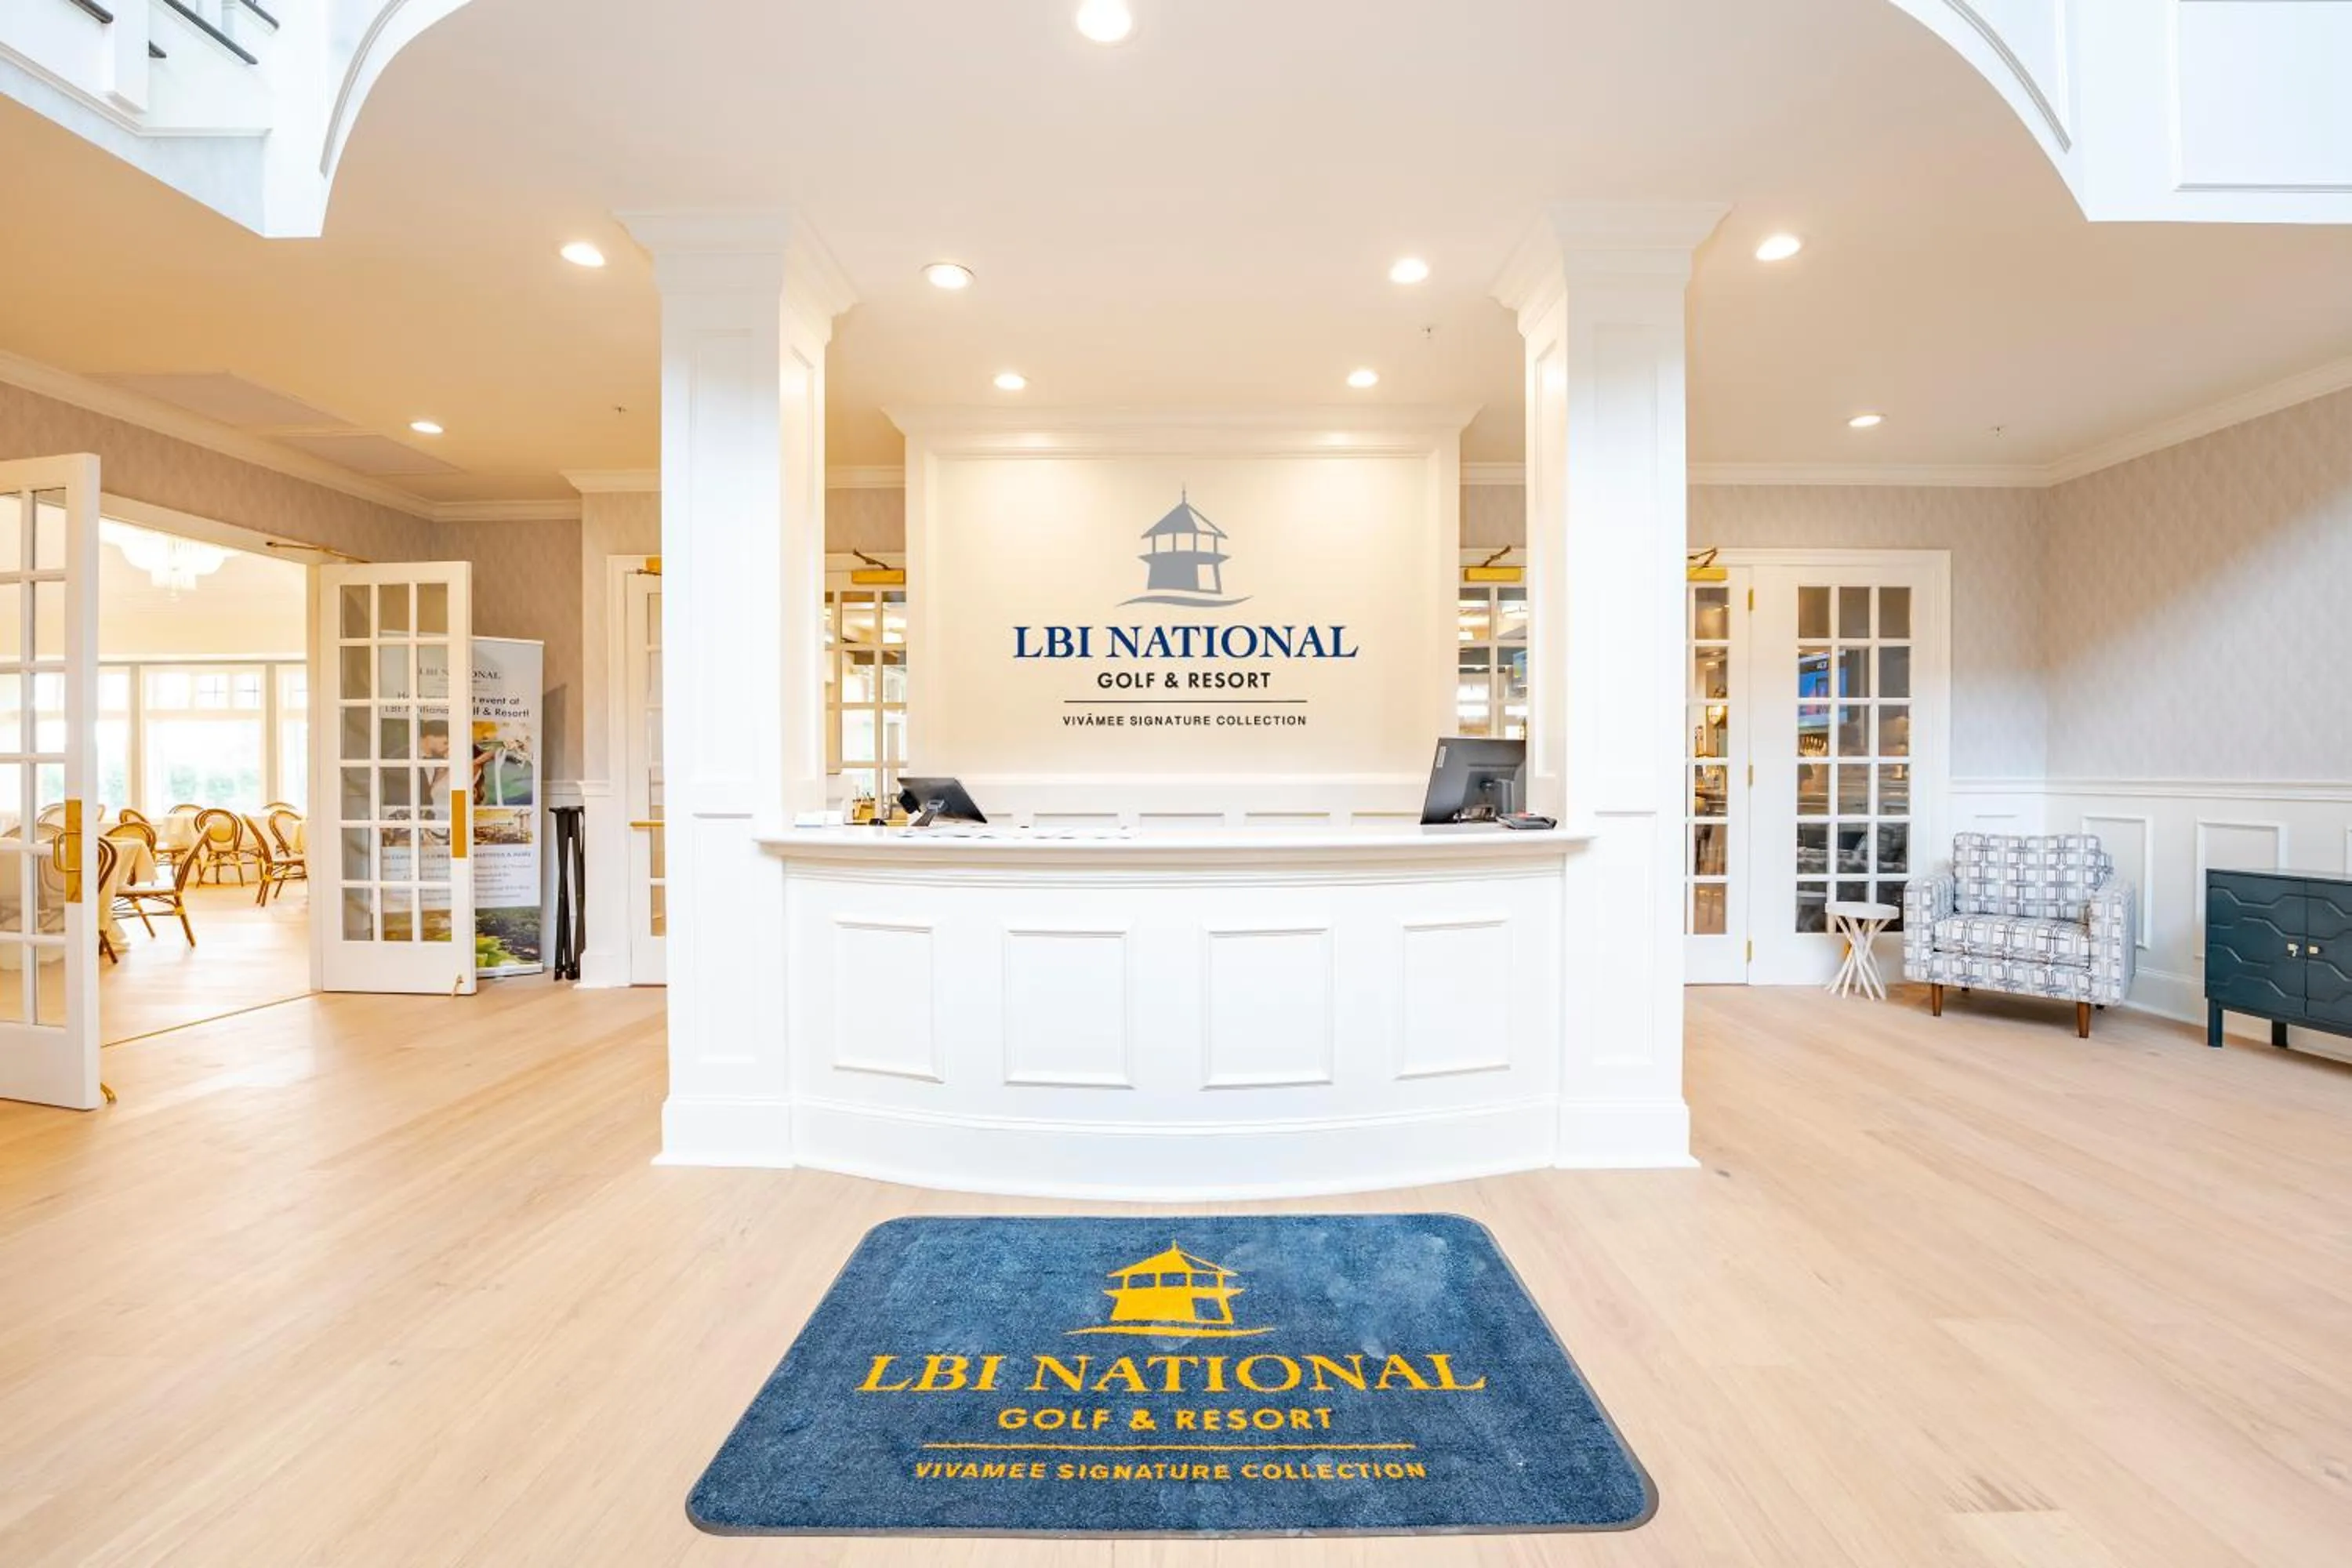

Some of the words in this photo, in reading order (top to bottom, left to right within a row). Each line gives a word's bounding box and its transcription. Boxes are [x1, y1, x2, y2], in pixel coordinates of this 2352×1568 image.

[1012, 626, 1094, 659] LBI
[1105, 625, 1359, 659] NATIONAL
[1097, 672, 1156, 689] GOLF
[1164, 672, 1179, 689] &
[1188, 672, 1272, 689] RESORT
[1130, 715, 1210, 726] SIGNATURE
[1216, 715, 1307, 726] COLLECTION
[855, 1354, 1007, 1392] LBI
[1025, 1354, 1485, 1392] NATIONAL
[997, 1407, 1112, 1431] GOLF
[1129, 1408, 1156, 1431] &
[1175, 1407, 1331, 1431] RESORT
[915, 1462, 1046, 1479] VIVAMEE
[1058, 1462, 1231, 1480] SIGNATURE
[1240, 1461, 1426, 1479] COLLECTION
